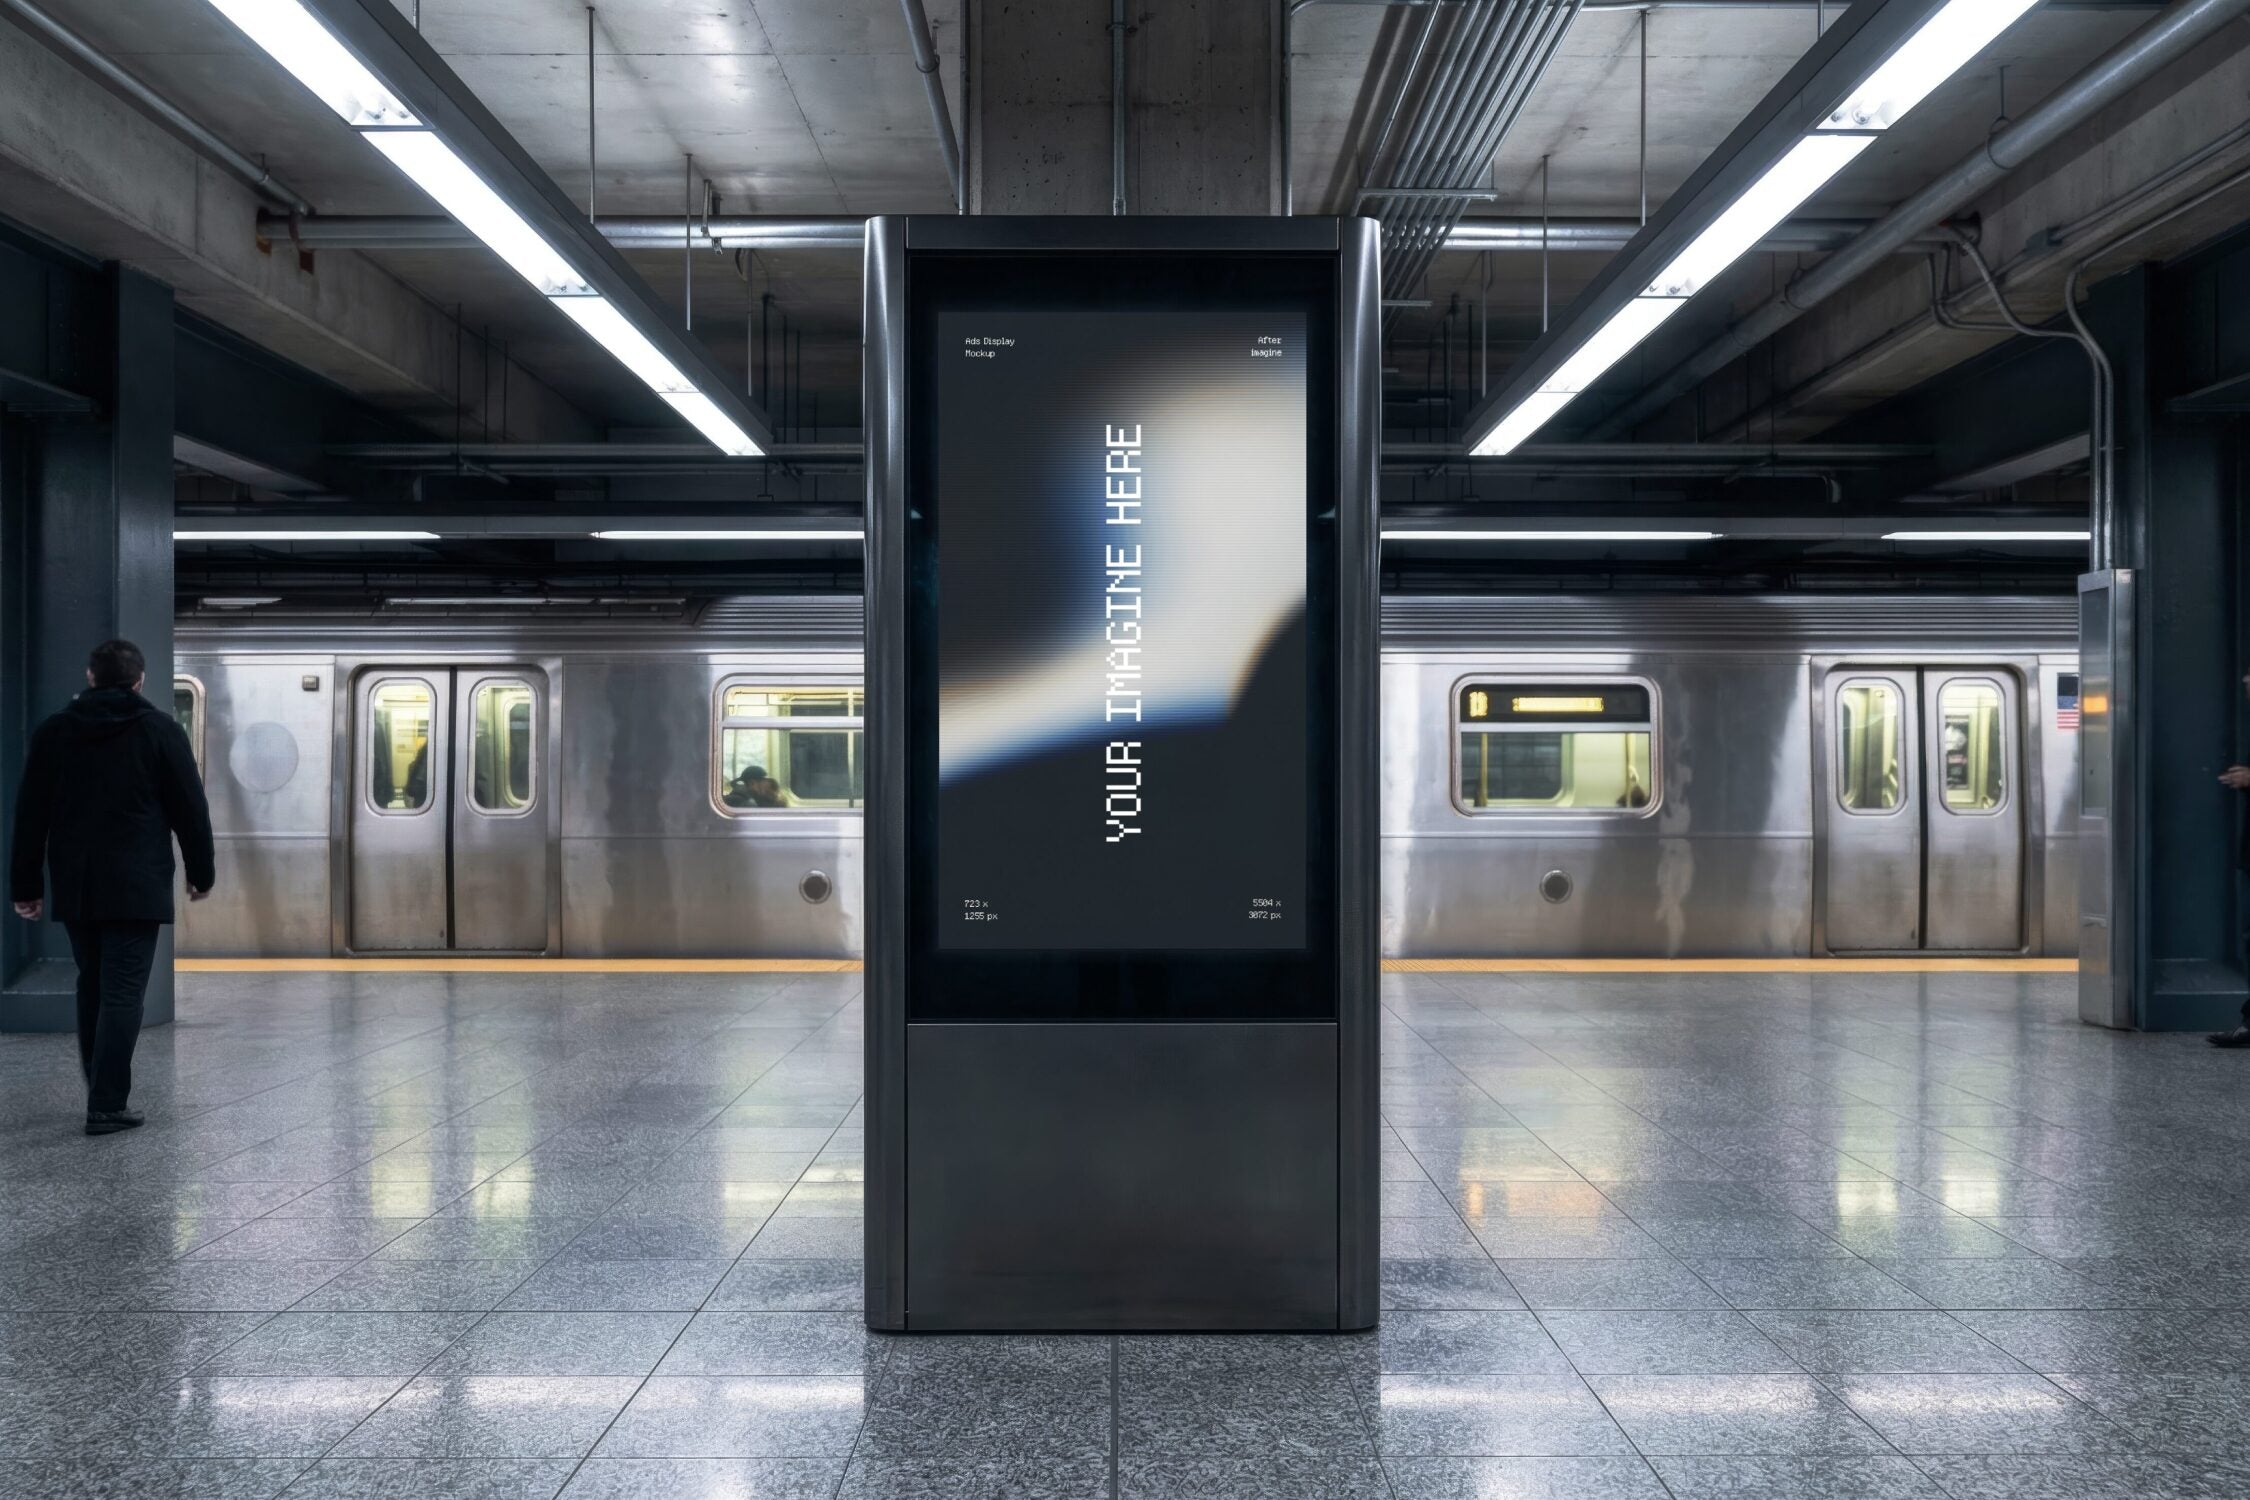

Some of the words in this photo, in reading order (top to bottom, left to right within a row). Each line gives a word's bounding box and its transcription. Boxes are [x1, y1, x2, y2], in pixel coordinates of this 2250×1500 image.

[965, 337, 981, 345] Ads
[983, 337, 1015, 347] Display
[1257, 336, 1282, 344] After
[965, 349, 996, 359] Mockup
[1106, 424, 1142, 524] HERE
[1106, 545, 1142, 721] IMAGINE
[1106, 742, 1142, 842] YOUR
[964, 899, 981, 908] 723
[1252, 898, 1273, 907] 5504
[964, 911, 985, 920] 1255
[987, 913, 998, 921] px
[1270, 912, 1282, 920] px
